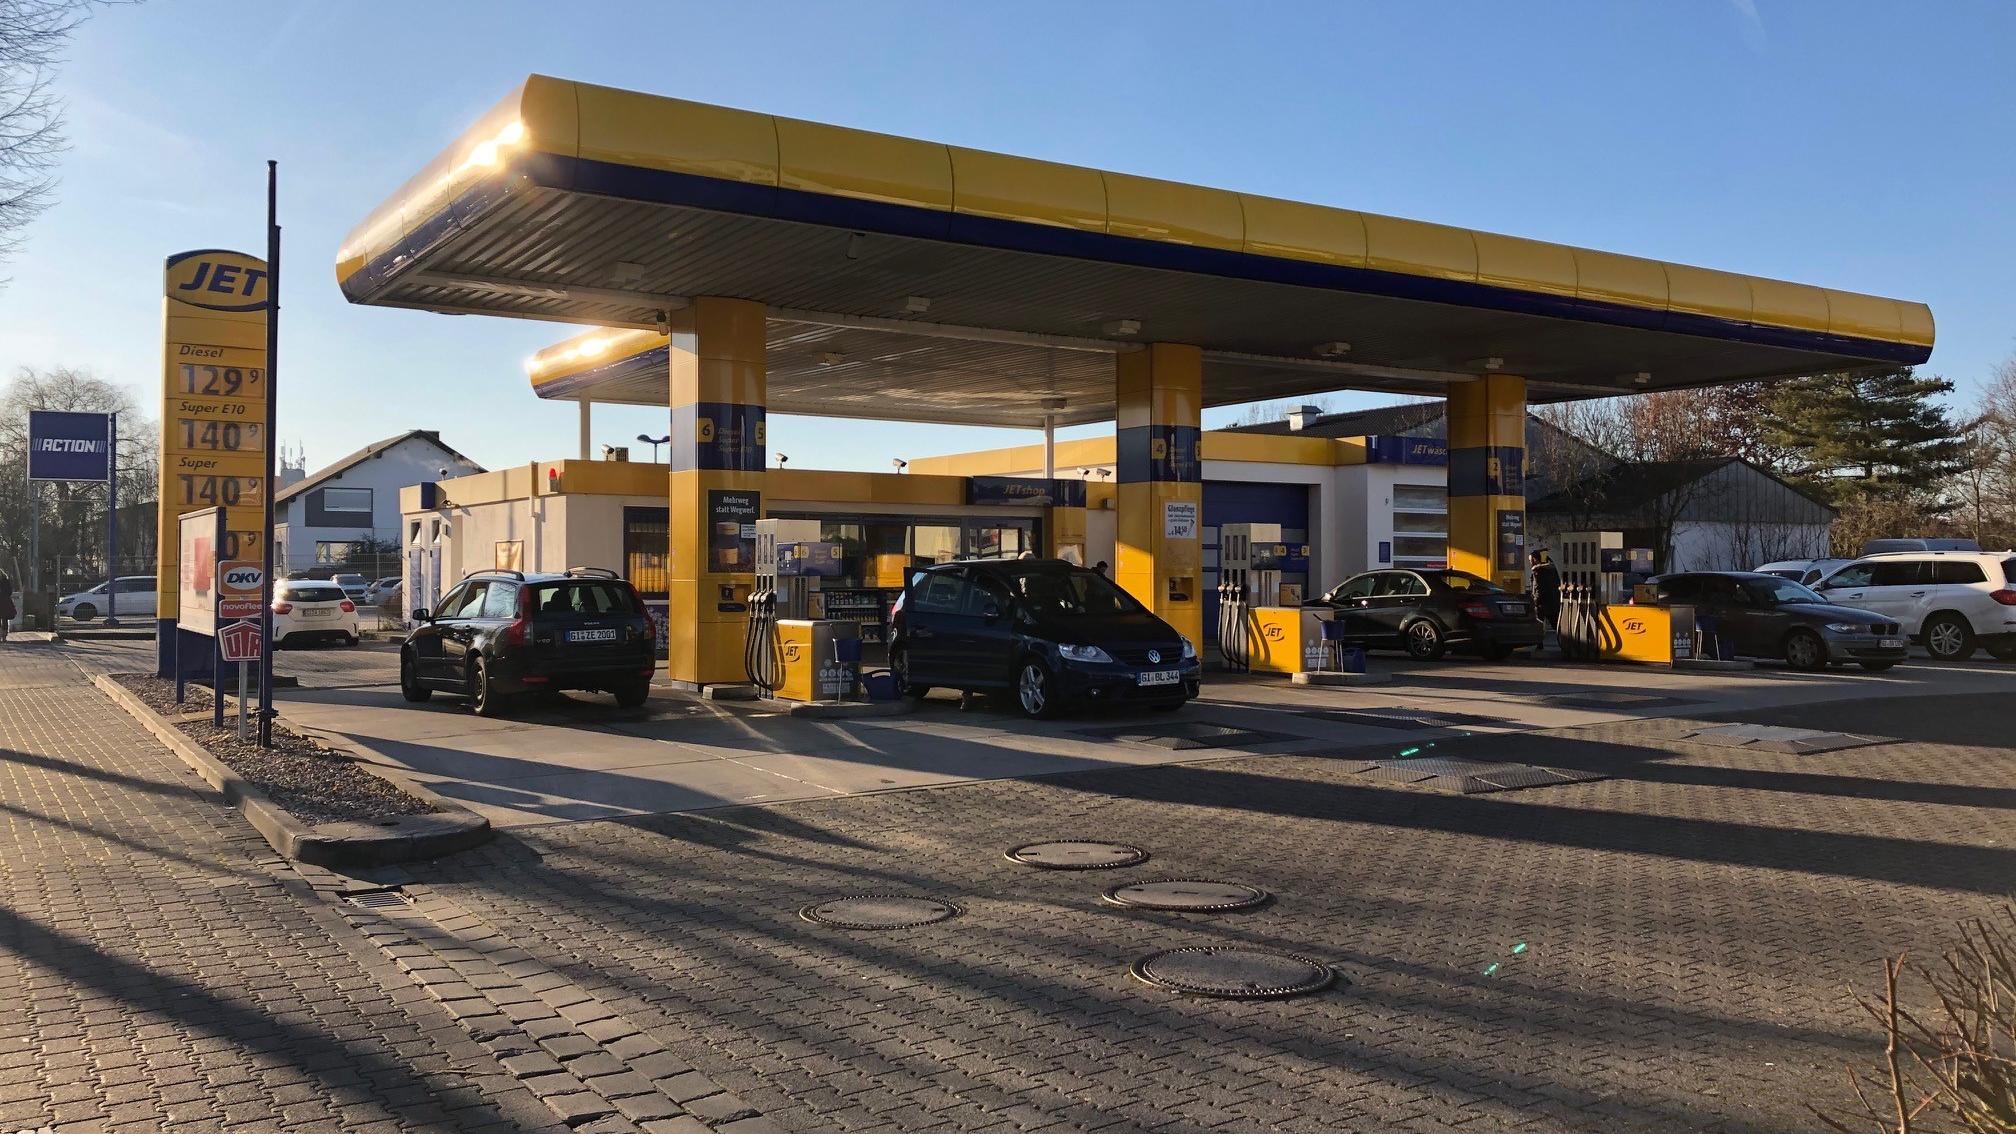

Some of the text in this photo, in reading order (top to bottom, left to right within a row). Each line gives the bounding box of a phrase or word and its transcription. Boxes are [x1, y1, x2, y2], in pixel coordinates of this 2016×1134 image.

[179, 262, 267, 297] JET
[179, 344, 224, 358] Diesel
[181, 365, 243, 397] 129
[179, 401, 246, 415] Super E10
[180, 419, 241, 451] 140
[702, 424, 711, 436] 6
[42, 438, 96, 453] ACTION
[1412, 444, 1448, 456] JETwasc
[179, 457, 218, 470] Super
[180, 475, 241, 507] 140
[723, 496, 749, 505] Mehrweg
[226, 572, 262, 584] DKV
[223, 602, 262, 610] novoflee
[1265, 627, 1283, 637] JET
[1625, 621, 1644, 631] JET
[785, 646, 799, 657] JET
